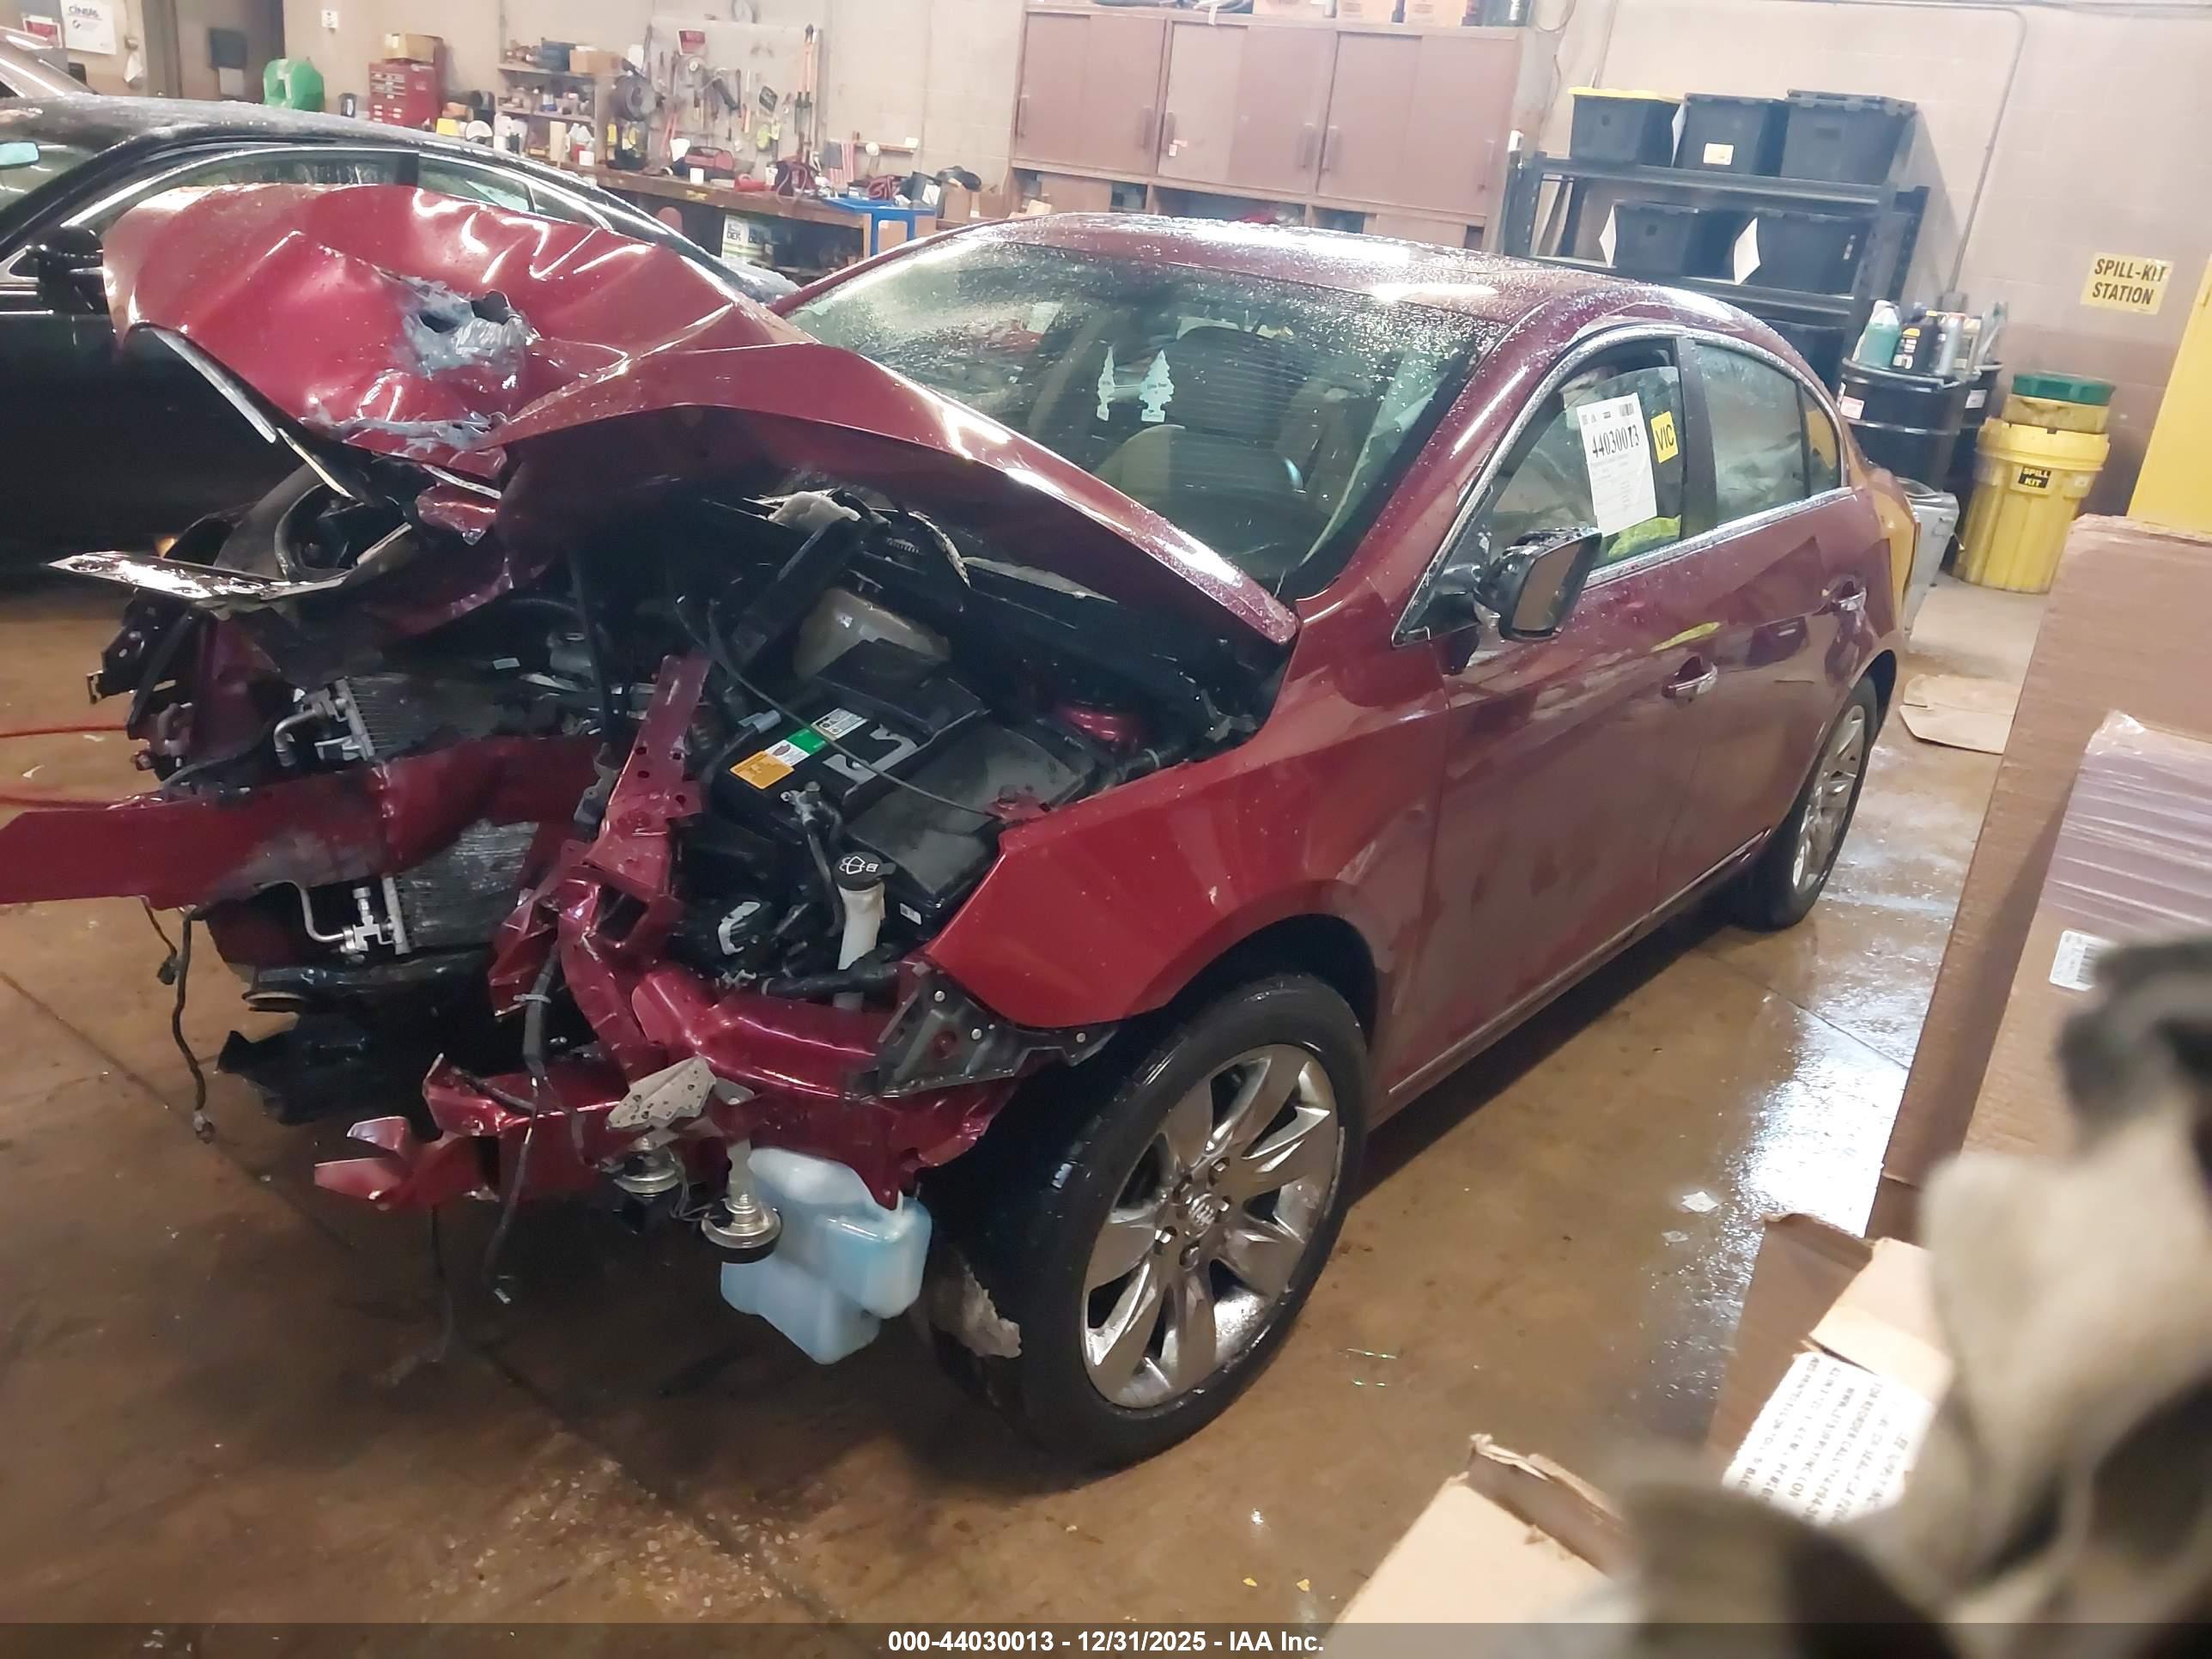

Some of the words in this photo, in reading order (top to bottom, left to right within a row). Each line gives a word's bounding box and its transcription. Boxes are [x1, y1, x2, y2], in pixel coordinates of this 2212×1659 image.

[2094, 258, 2168, 282] SPILL-KIT
[2093, 282, 2154, 305] STATION
[1656, 424, 1674, 451] VIC
[2022, 467, 2049, 478] SPILL
[2025, 477, 2042, 486] KIT
